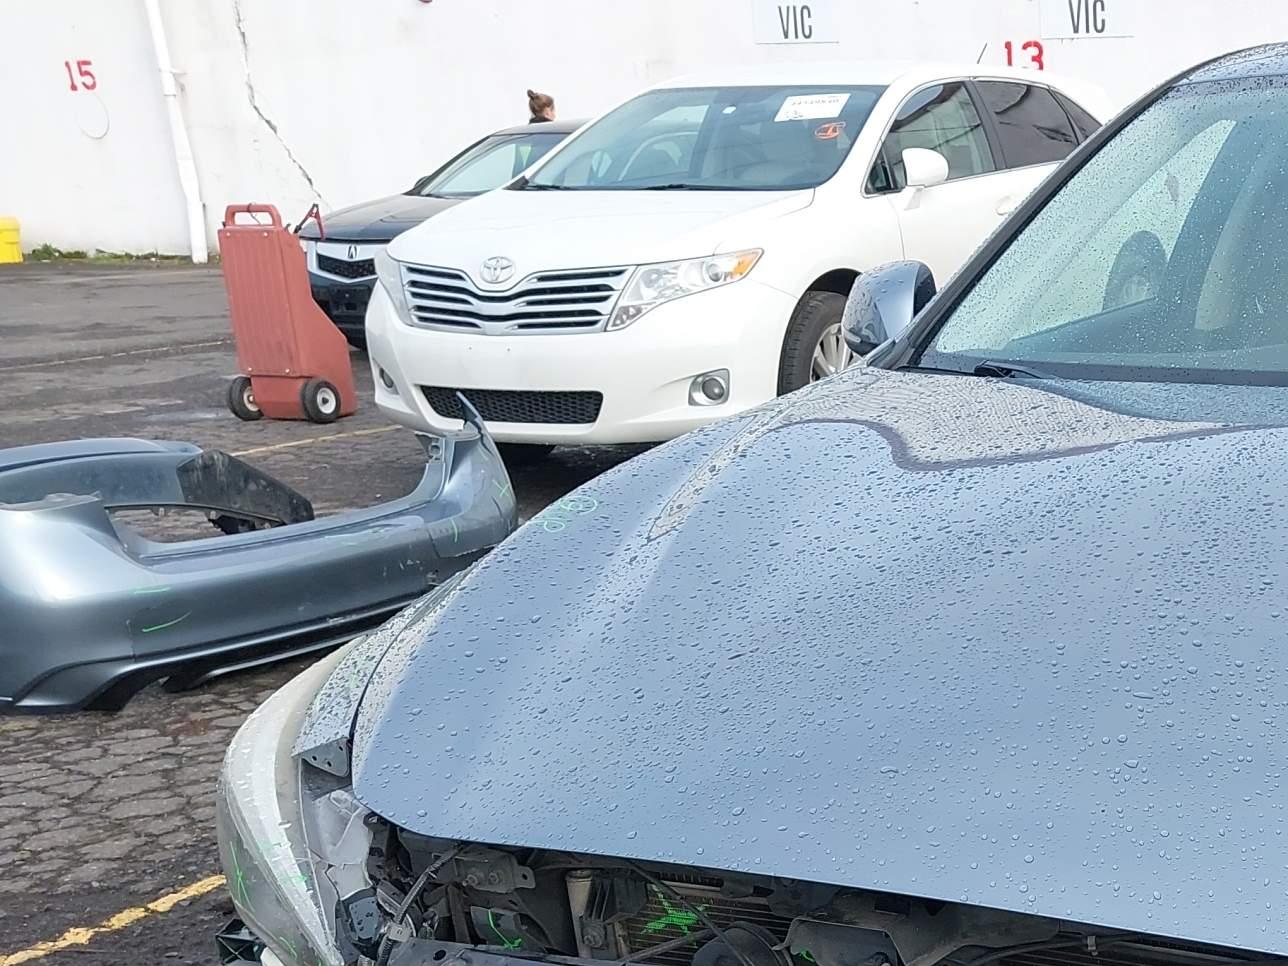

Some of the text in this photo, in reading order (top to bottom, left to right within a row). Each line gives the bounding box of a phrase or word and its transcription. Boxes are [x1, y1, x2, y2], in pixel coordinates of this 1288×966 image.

[778, 5, 813, 39] VIC
[1068, 0, 1106, 34] VIC
[1005, 41, 1043, 70] 13
[65, 60, 97, 91] 15
